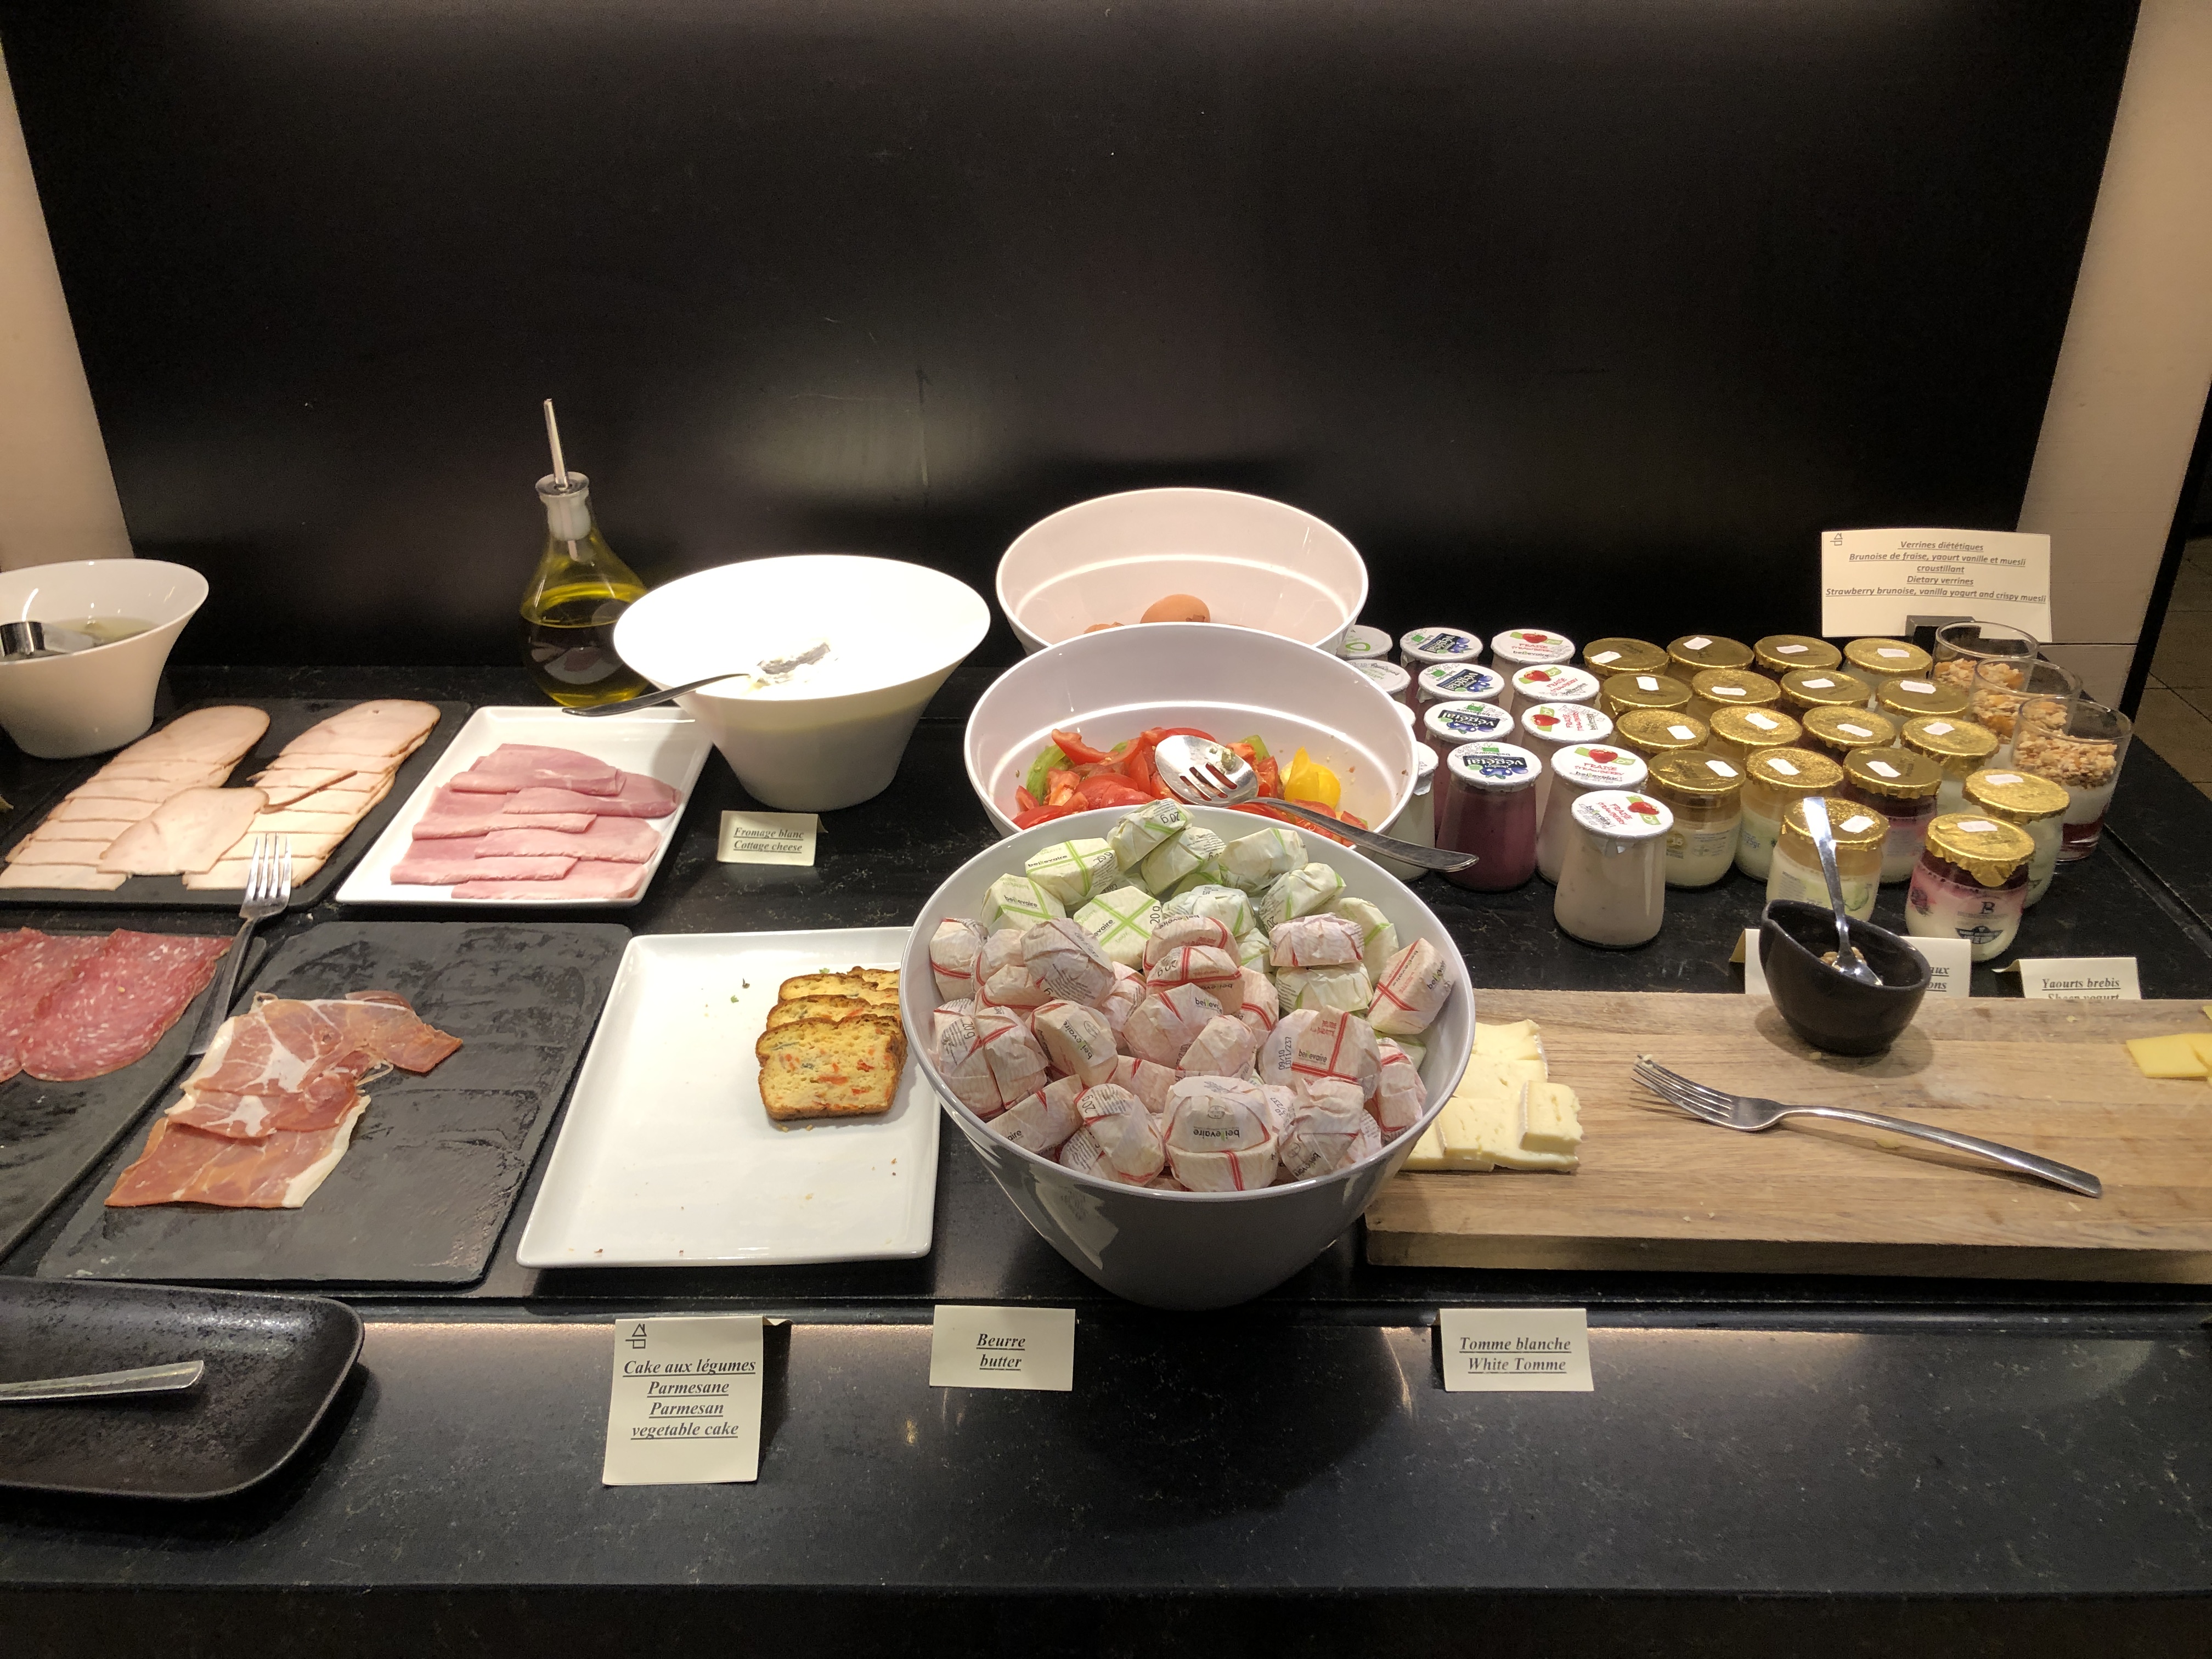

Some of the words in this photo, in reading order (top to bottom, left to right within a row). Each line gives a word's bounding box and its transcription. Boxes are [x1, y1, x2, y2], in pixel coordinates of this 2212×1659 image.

[1900, 541, 1936, 549] Verrines
[1938, 541, 1983, 552] diététiques
[1903, 552, 1929, 562] fraise,
[1932, 554, 1960, 562] yaourt
[1962, 555, 1988, 563] vanille
[2000, 557, 2026, 566] muesli
[1917, 565, 1965, 573] croustillant
[1906, 575, 1938, 585] Dietary
[1940, 577, 1973, 585] verrines
[1825, 588, 1875, 597] Strawberry
[1877, 588, 1917, 596] brunoise,
[1950, 589, 1977, 599] yogurt
[1979, 590, 1994, 599] and
[1996, 591, 2019, 602] crispy
[2021, 594, 2046, 603] muesli
[1466, 758, 1524, 766] végétal
[734, 827, 776, 838] Fromage
[778, 829, 804, 838] blanc
[734, 840, 769, 851] Cottage
[772, 842, 802, 851] cheese
[2042, 979, 2083, 988] Yaourts
[2087, 978, 2119, 987] brebis
[977, 1333, 1025, 1347] Beurre
[1460, 1337, 1511, 1350] Tomme
[1516, 1337, 1571, 1350] blanche
[624, 1360, 661, 1374] Cake
[665, 1362, 692, 1373] aux
[697, 1358, 755, 1375] légumes
[980, 1354, 1022, 1367] butter
[1469, 1358, 1508, 1370] White
[1515, 1358, 1566, 1370] Tomme
[647, 1381, 730, 1395] Parmesane
[649, 1402, 724, 1415] Parmesan
[632, 1423, 700, 1439] vegetable
[704, 1421, 738, 1435] cake
